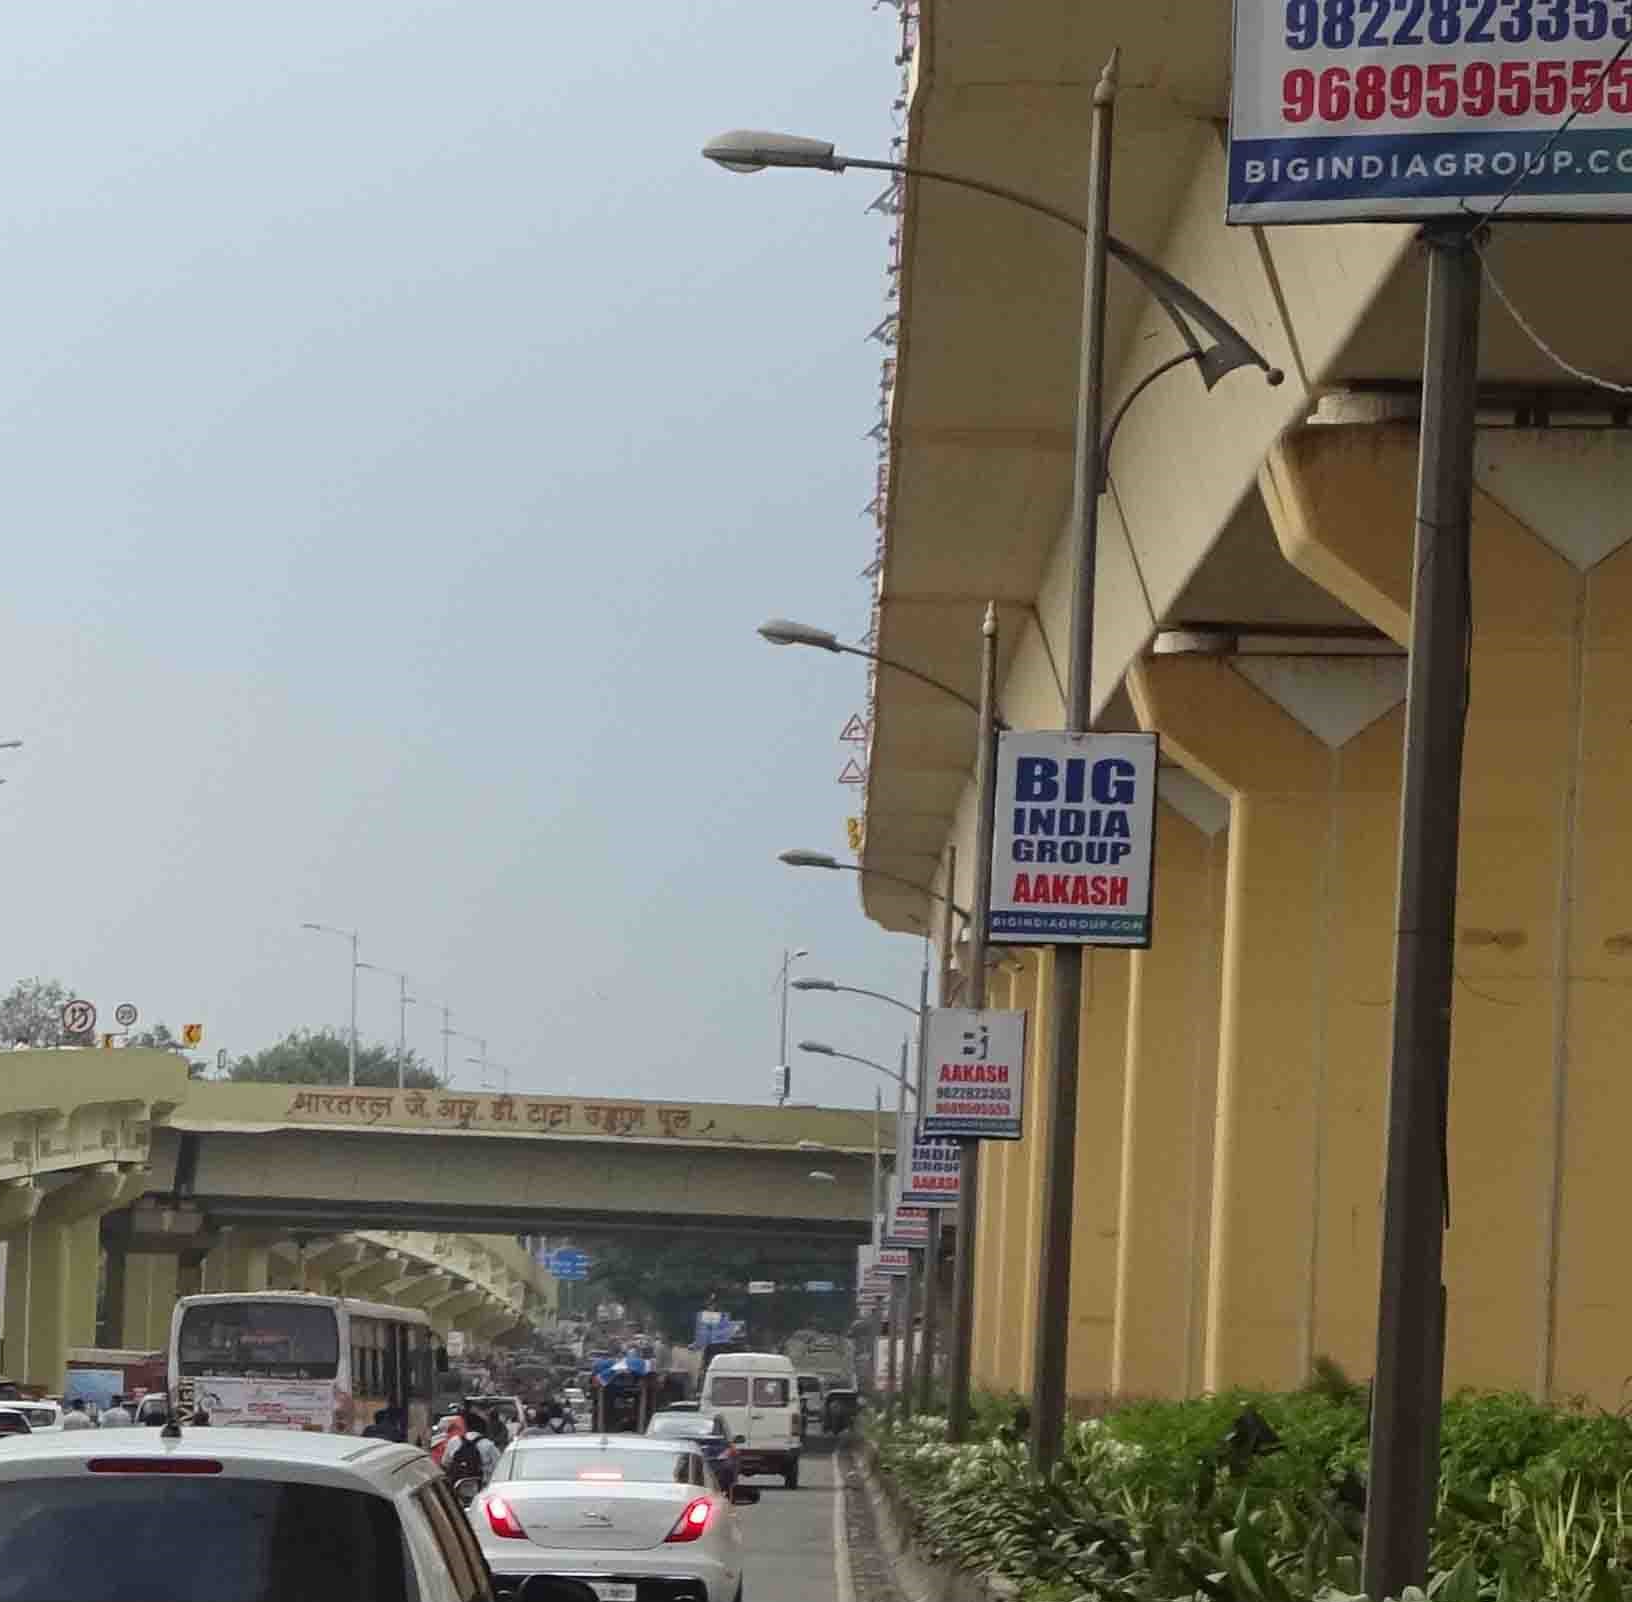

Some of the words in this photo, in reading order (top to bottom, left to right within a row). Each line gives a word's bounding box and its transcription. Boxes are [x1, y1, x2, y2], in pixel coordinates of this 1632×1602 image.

[1016, 756, 1135, 804] BIG
[1014, 808, 1130, 837] INDIA
[1012, 839, 1132, 865] GROUP
[1013, 873, 1129, 906] AAKASH
[939, 1064, 1009, 1083] AAKASH
